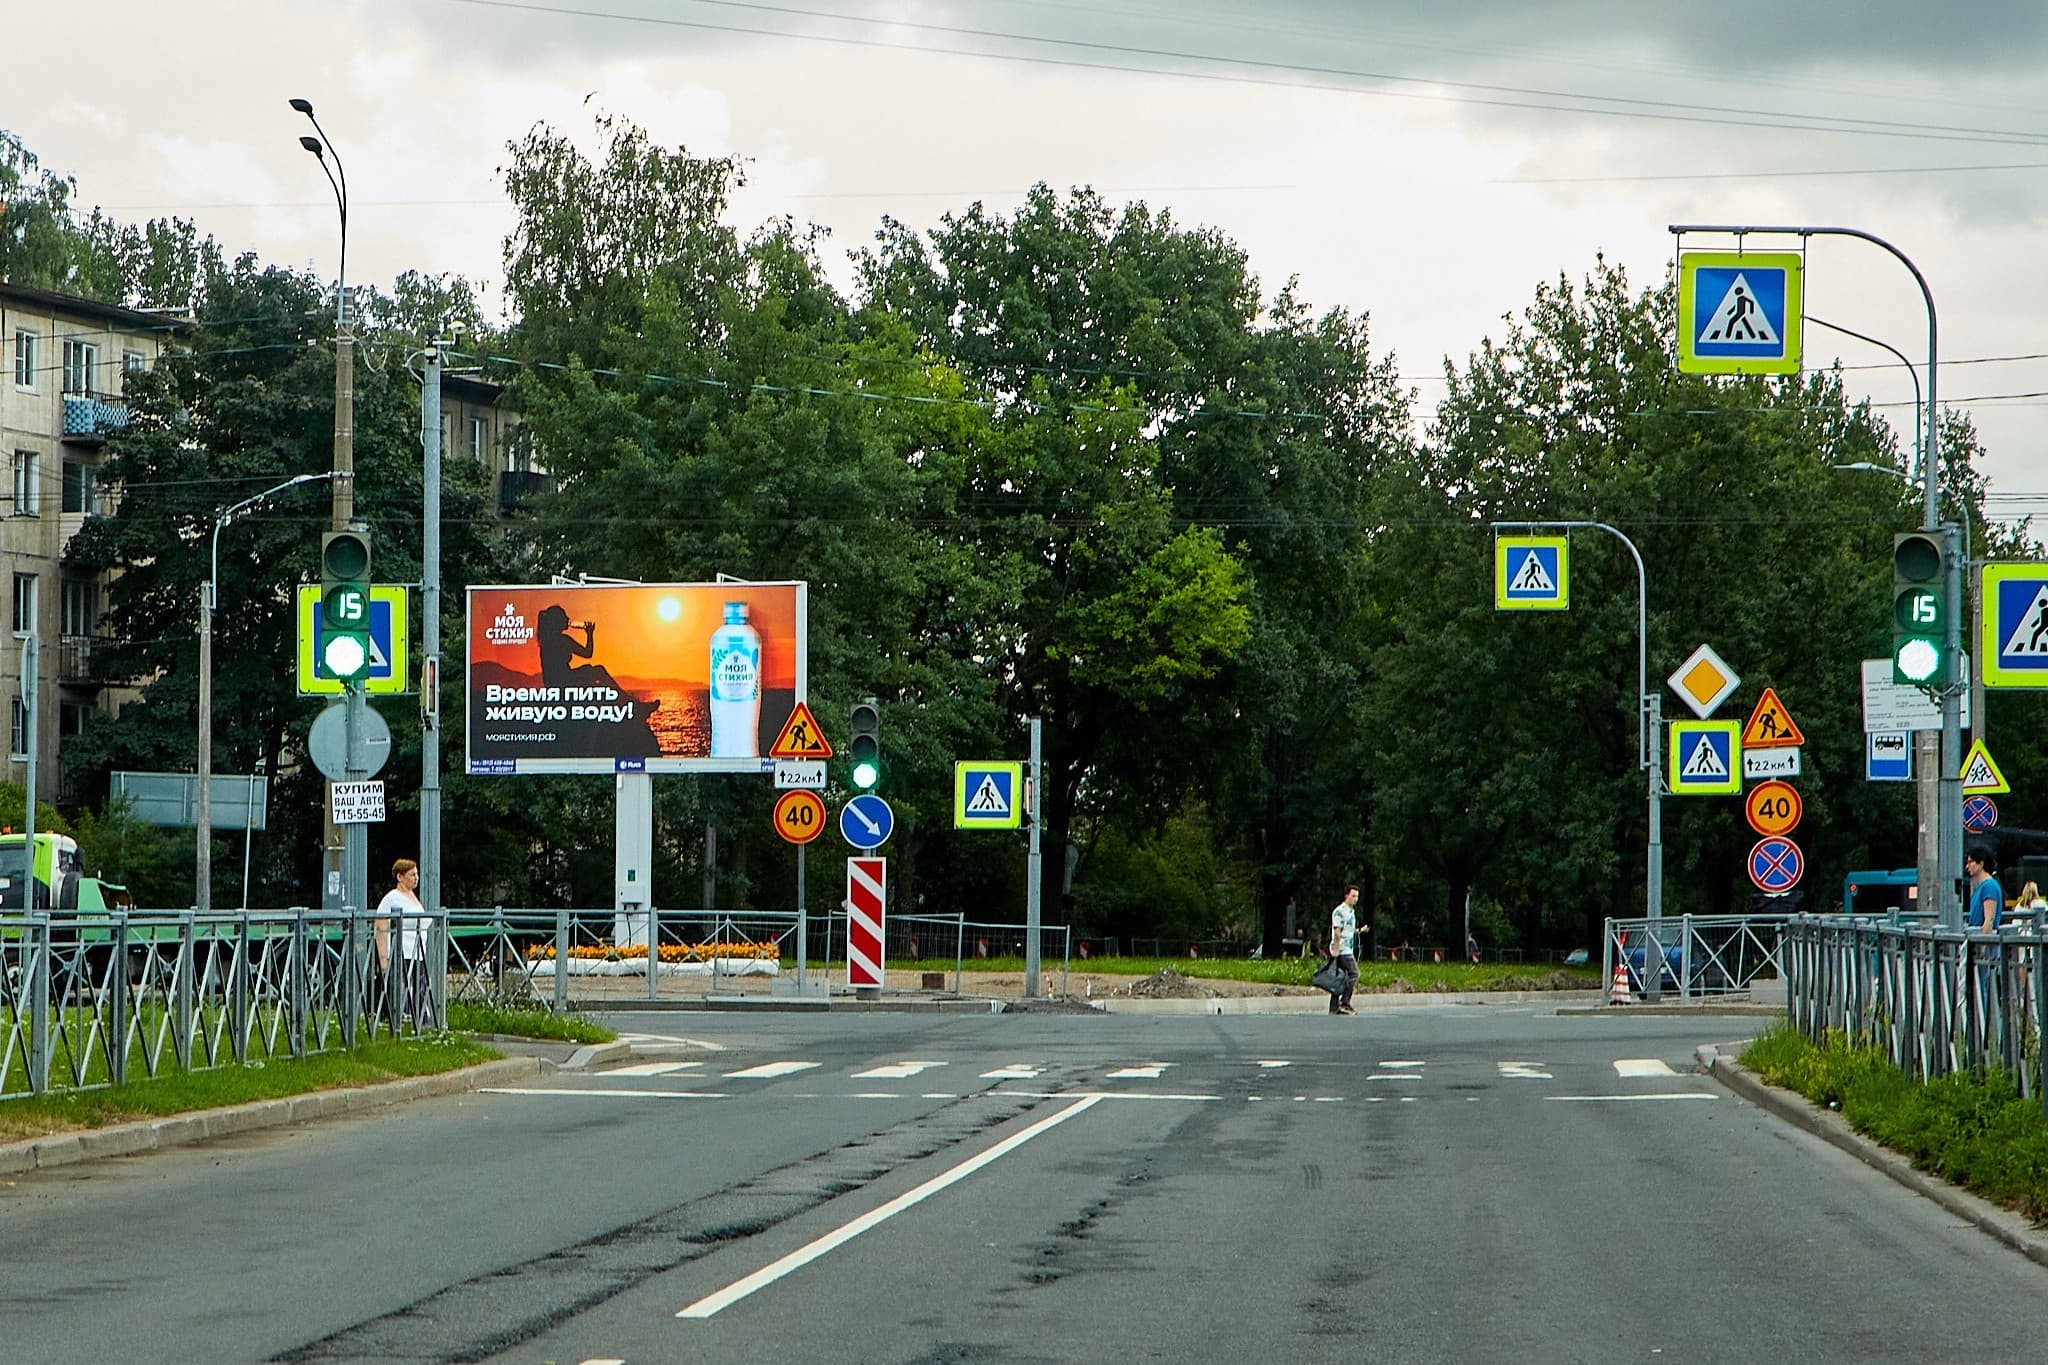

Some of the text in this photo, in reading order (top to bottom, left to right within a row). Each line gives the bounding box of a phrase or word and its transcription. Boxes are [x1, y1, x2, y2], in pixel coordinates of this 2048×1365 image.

[339, 592, 362, 619] 15
[1912, 595, 1936, 622] 15
[494, 615, 524, 628] МОЯ
[485, 627, 534, 639] СТИХИЯ
[725, 664, 747, 673] МОЯ
[486, 684, 618, 704] Время пить
[485, 701, 634, 724] живую воду!
[335, 784, 383, 795] КУПИМ
[334, 795, 384, 807] ВАШ АВТО
[1758, 797, 1791, 819] 40
[335, 807, 385, 821] 715-55-45
[785, 805, 813, 826] 40
